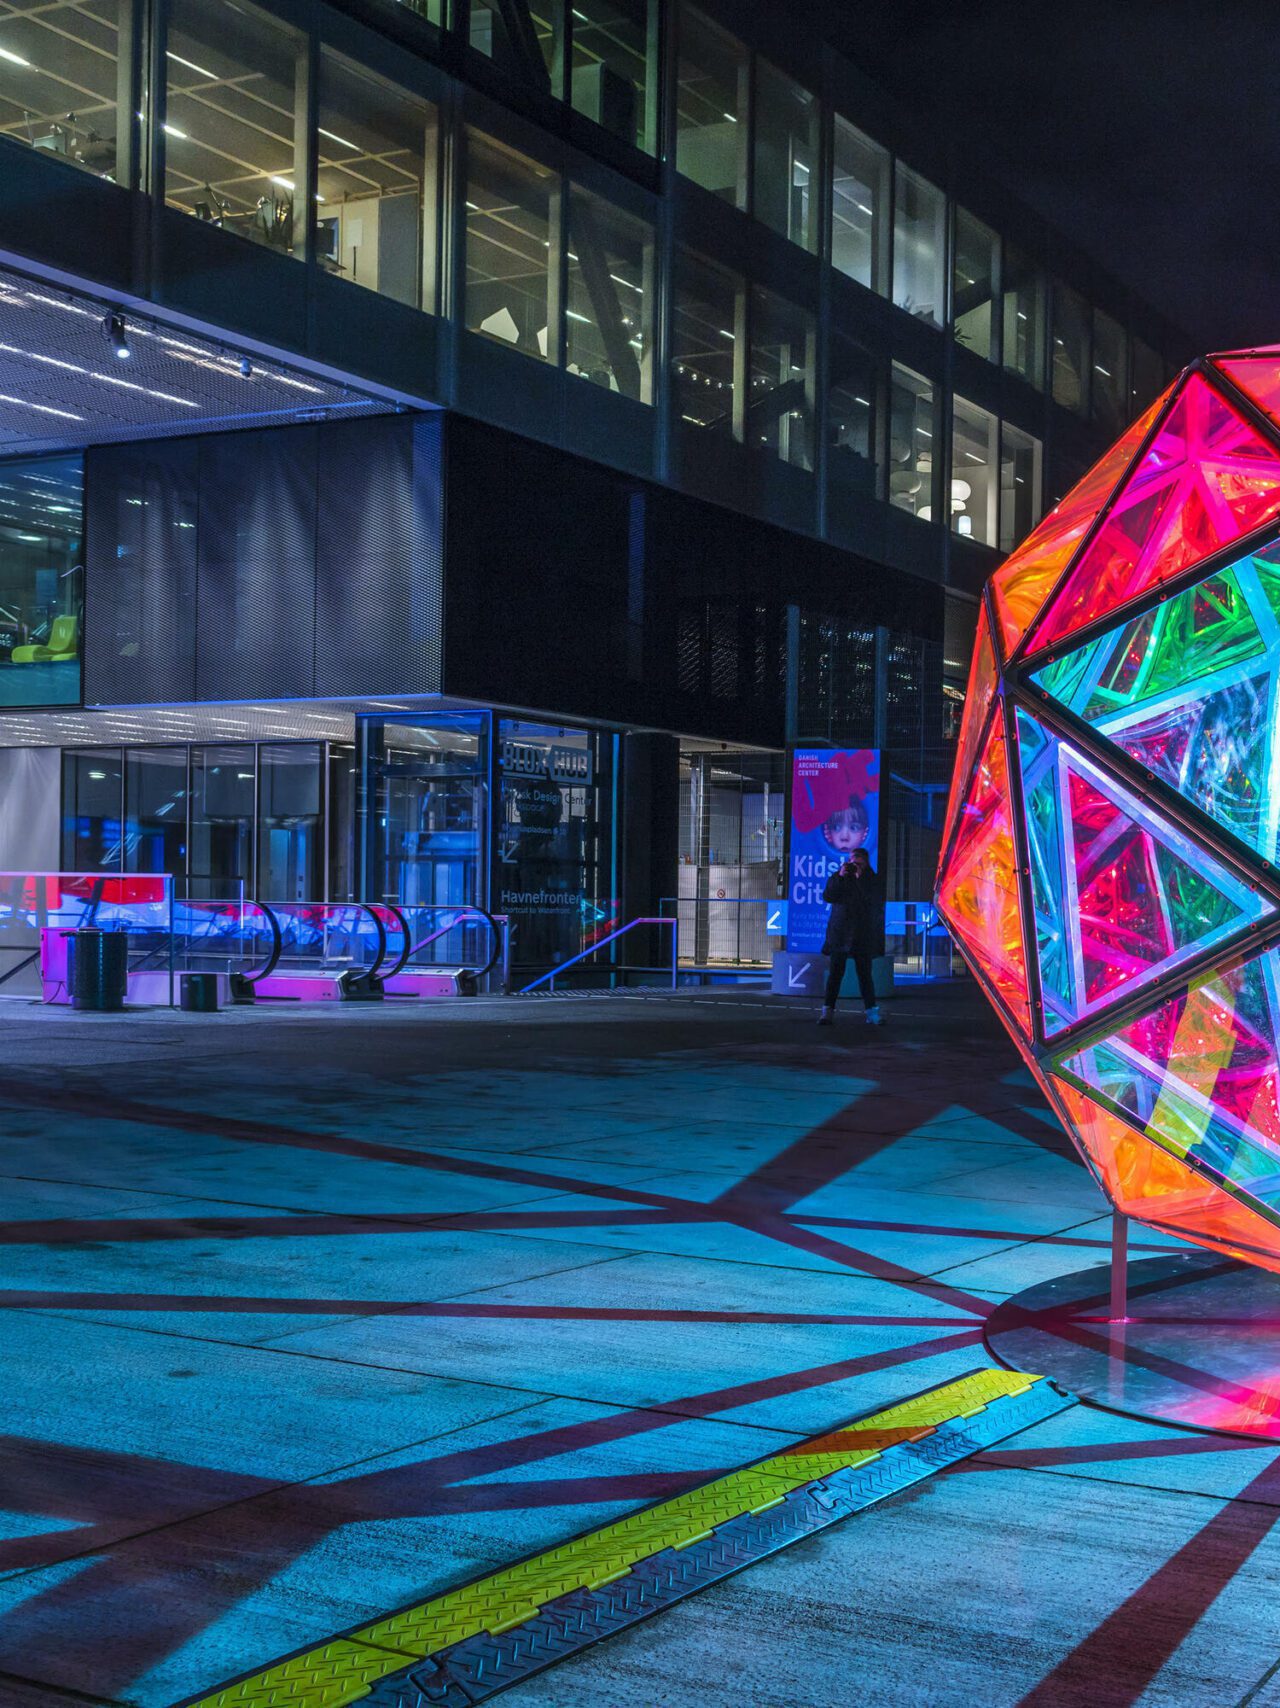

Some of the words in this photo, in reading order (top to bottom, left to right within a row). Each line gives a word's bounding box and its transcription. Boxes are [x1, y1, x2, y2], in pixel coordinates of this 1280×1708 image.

[503, 744, 546, 774] BLOX
[554, 751, 588, 778] HUB
[534, 790, 561, 805] Design
[794, 855, 846, 878] Kids'
[501, 889, 582, 905] Havnefronten
[793, 881, 832, 911] Cit
